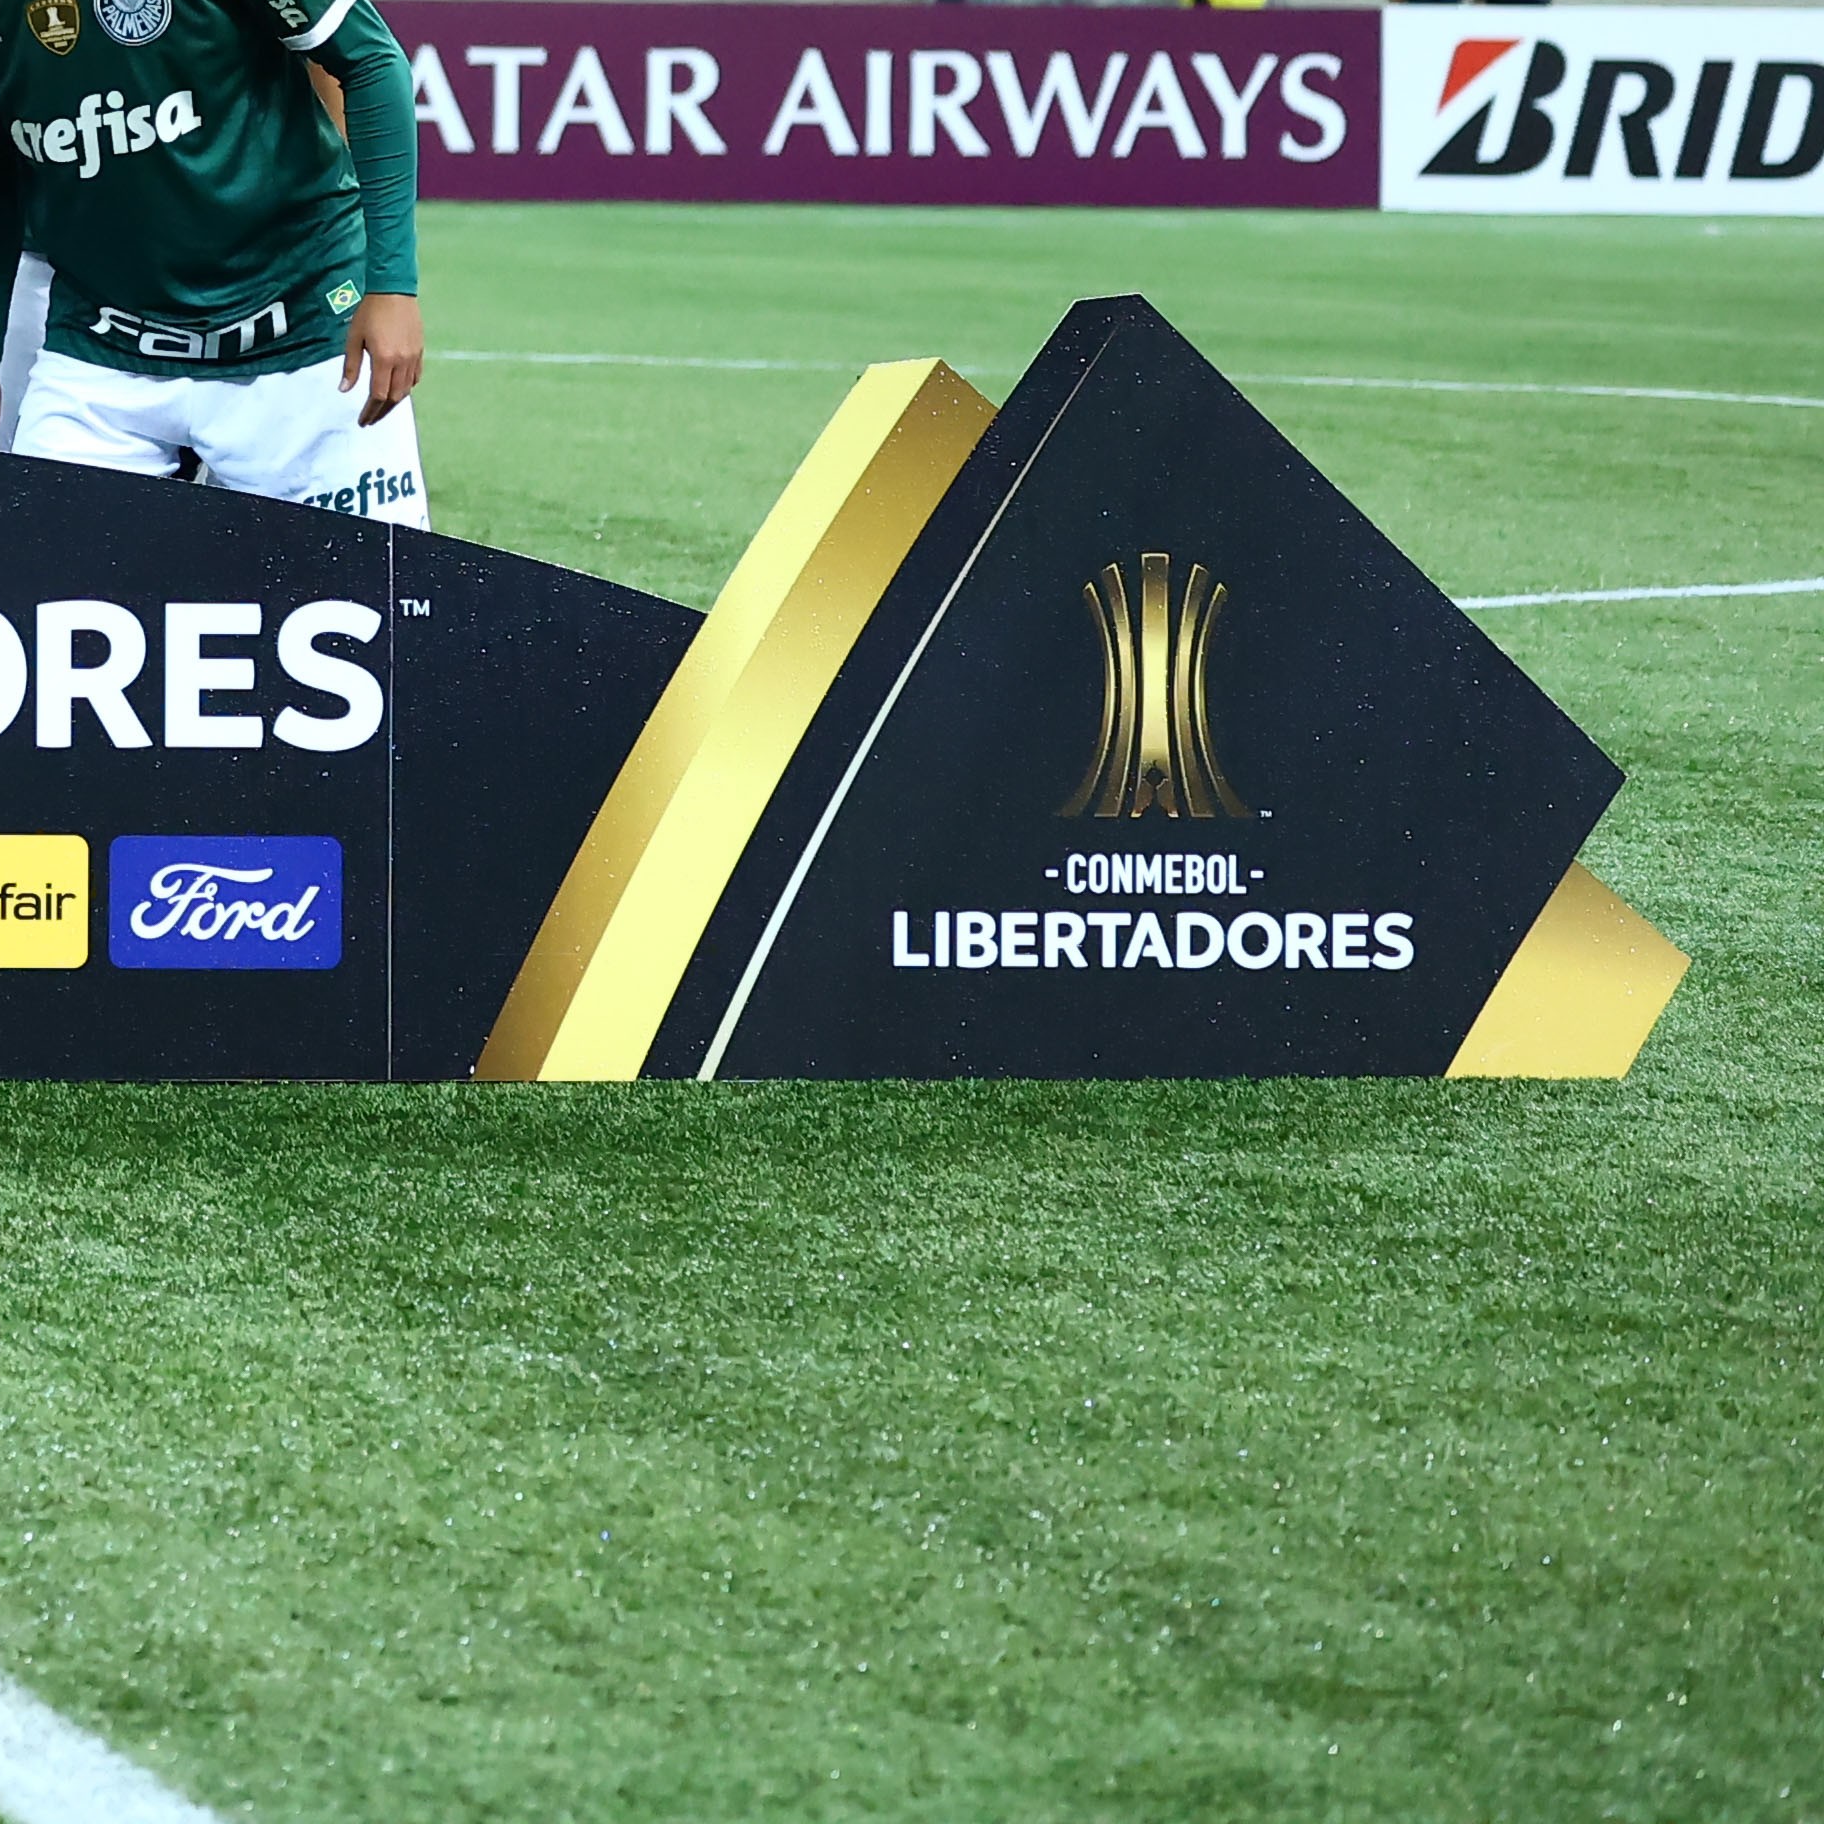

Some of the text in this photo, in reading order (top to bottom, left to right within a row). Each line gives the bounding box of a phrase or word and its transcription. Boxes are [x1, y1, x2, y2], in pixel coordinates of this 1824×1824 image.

[11, 90, 203, 179] crefisa
[412, 44, 1348, 164] ATAR AIRWAYS
[129, 862, 321, 942] Ford
[1065, 853, 1247, 895] CONMEBOL
[892, 910, 1415, 971] LIBERTADORES
